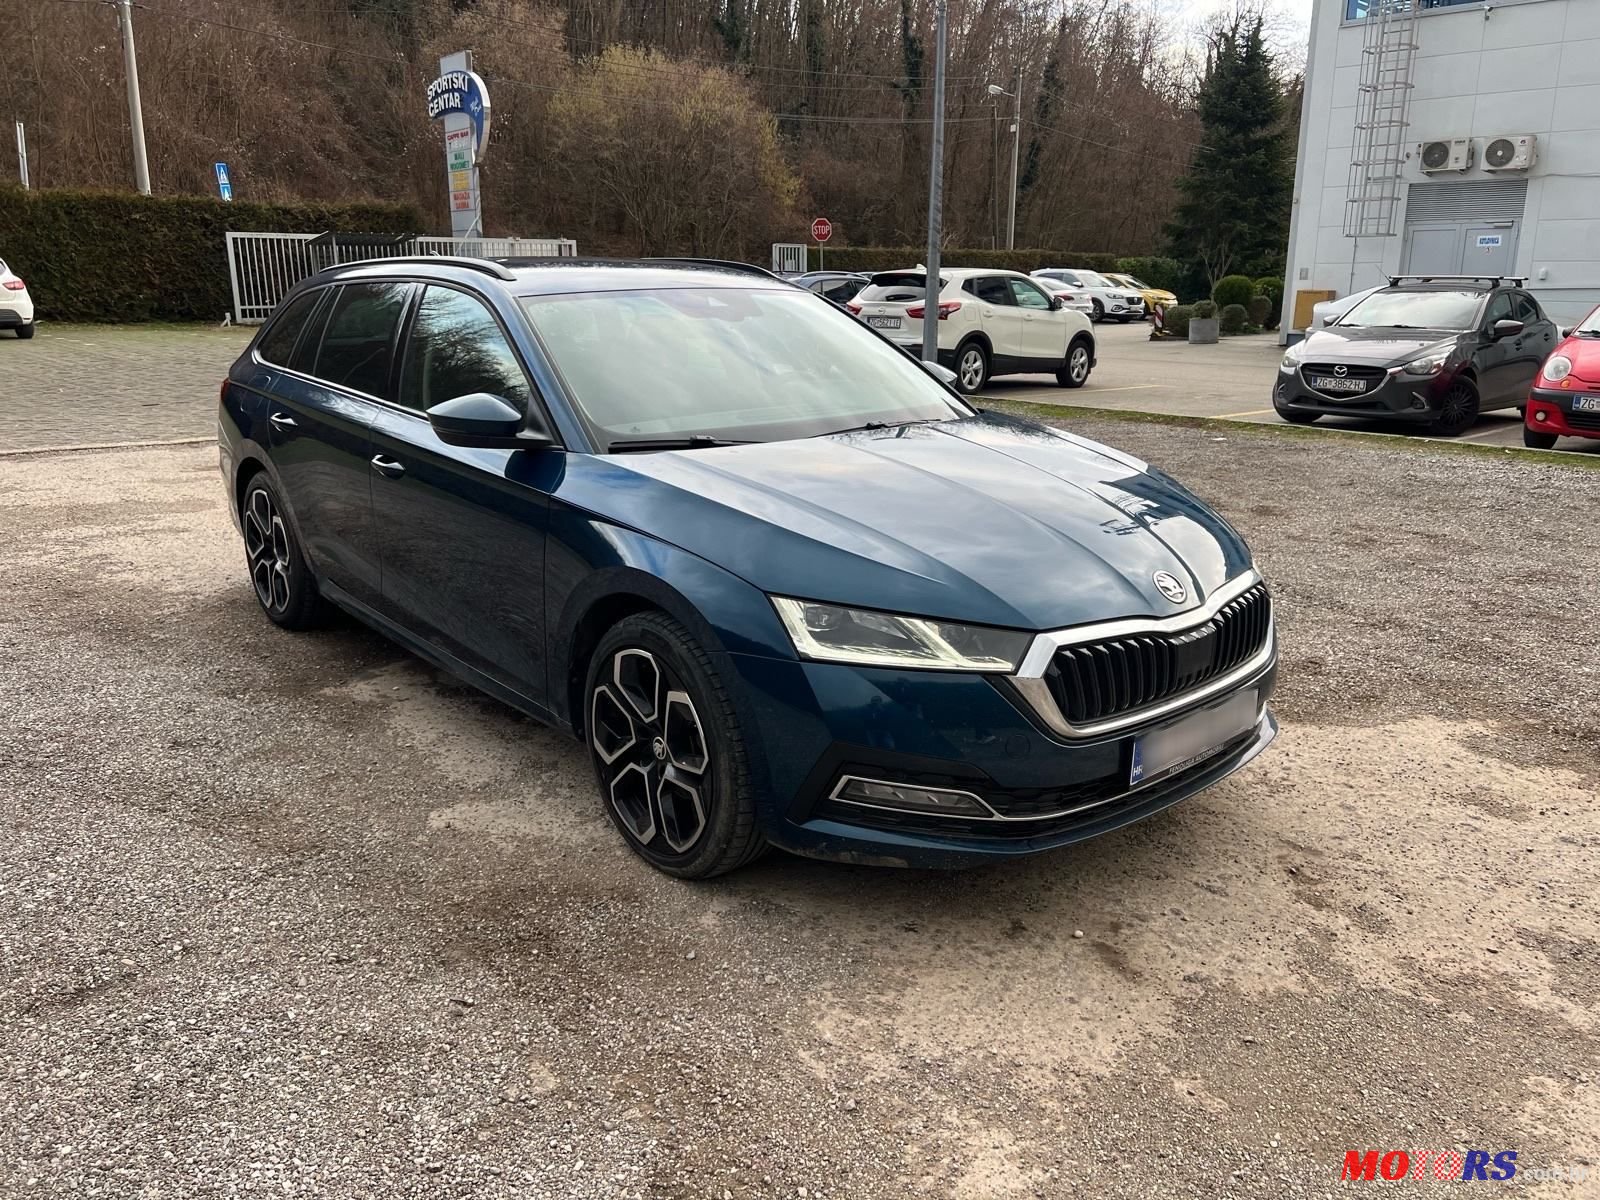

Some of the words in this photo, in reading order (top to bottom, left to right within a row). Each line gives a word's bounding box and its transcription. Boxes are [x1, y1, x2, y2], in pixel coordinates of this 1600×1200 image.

[427, 72, 469, 100] SPORTSKI
[428, 92, 461, 117] CENTAR
[813, 225, 830, 235] STOP
[1581, 398, 1595, 410] ZG
